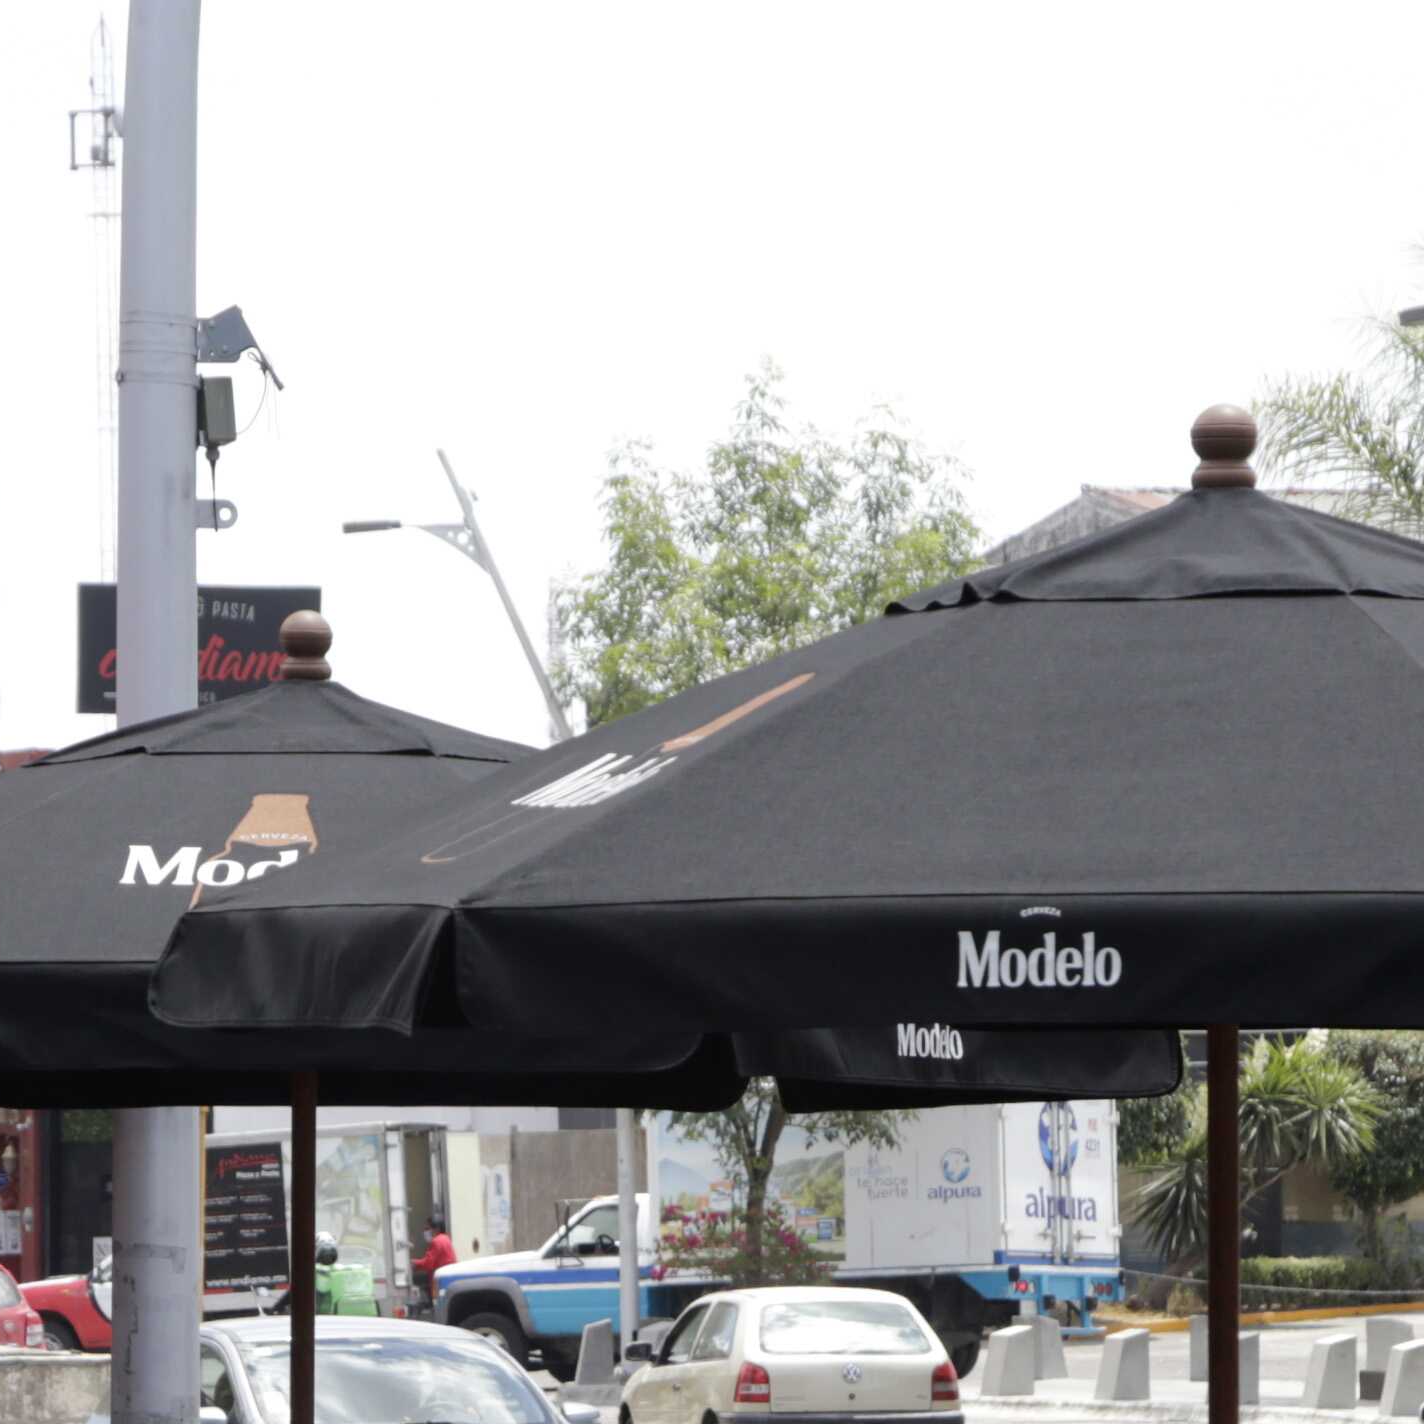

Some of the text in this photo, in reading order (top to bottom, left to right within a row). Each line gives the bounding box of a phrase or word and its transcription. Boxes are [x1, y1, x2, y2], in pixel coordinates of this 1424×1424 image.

[212, 600, 256, 622] PASTA
[1020, 906, 1062, 918] CERVEZA
[957, 930, 1122, 988] Modelo
[896, 1022, 964, 1060] Modelo
[927, 1183, 982, 1203] alpura
[1025, 1186, 1097, 1229] alpura
